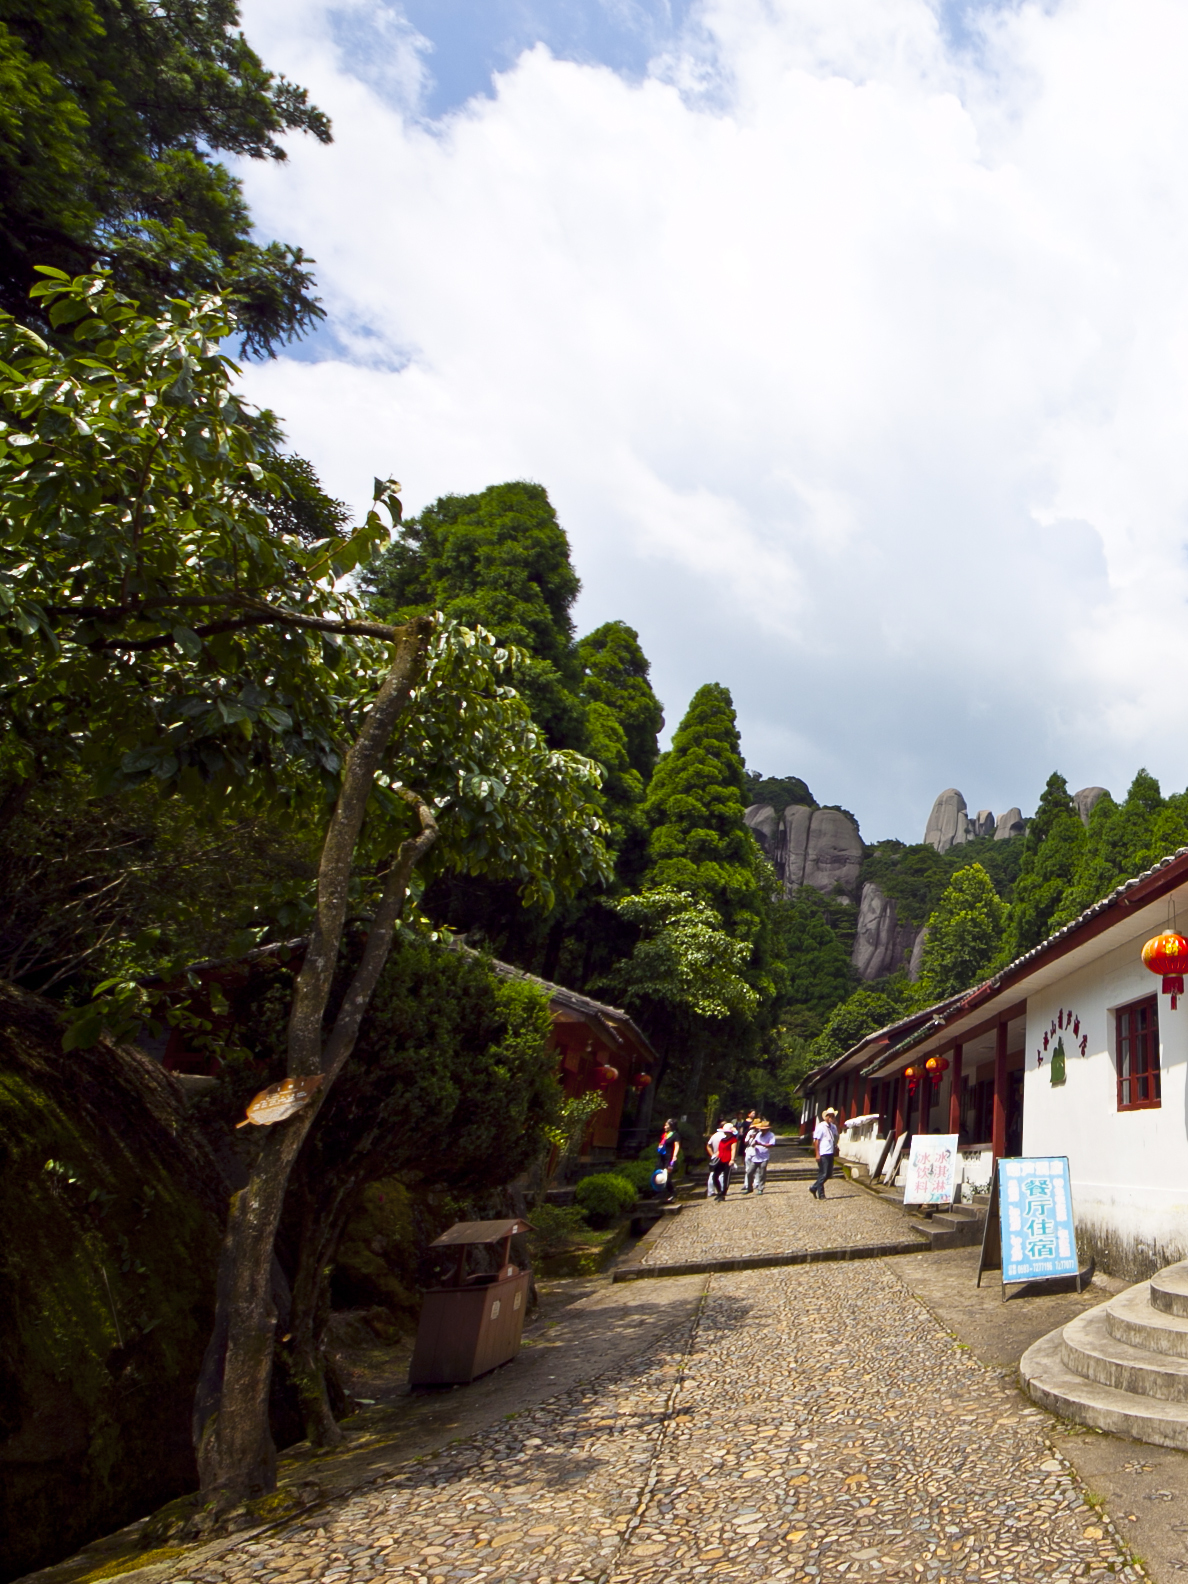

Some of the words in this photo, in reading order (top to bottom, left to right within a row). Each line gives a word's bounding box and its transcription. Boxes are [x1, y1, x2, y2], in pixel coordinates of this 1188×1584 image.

[914, 1151, 931, 1194] 冰饮料
[931, 1150, 948, 1193] 冰淇淋
[1023, 1178, 1055, 1260] 餐厅住宿
